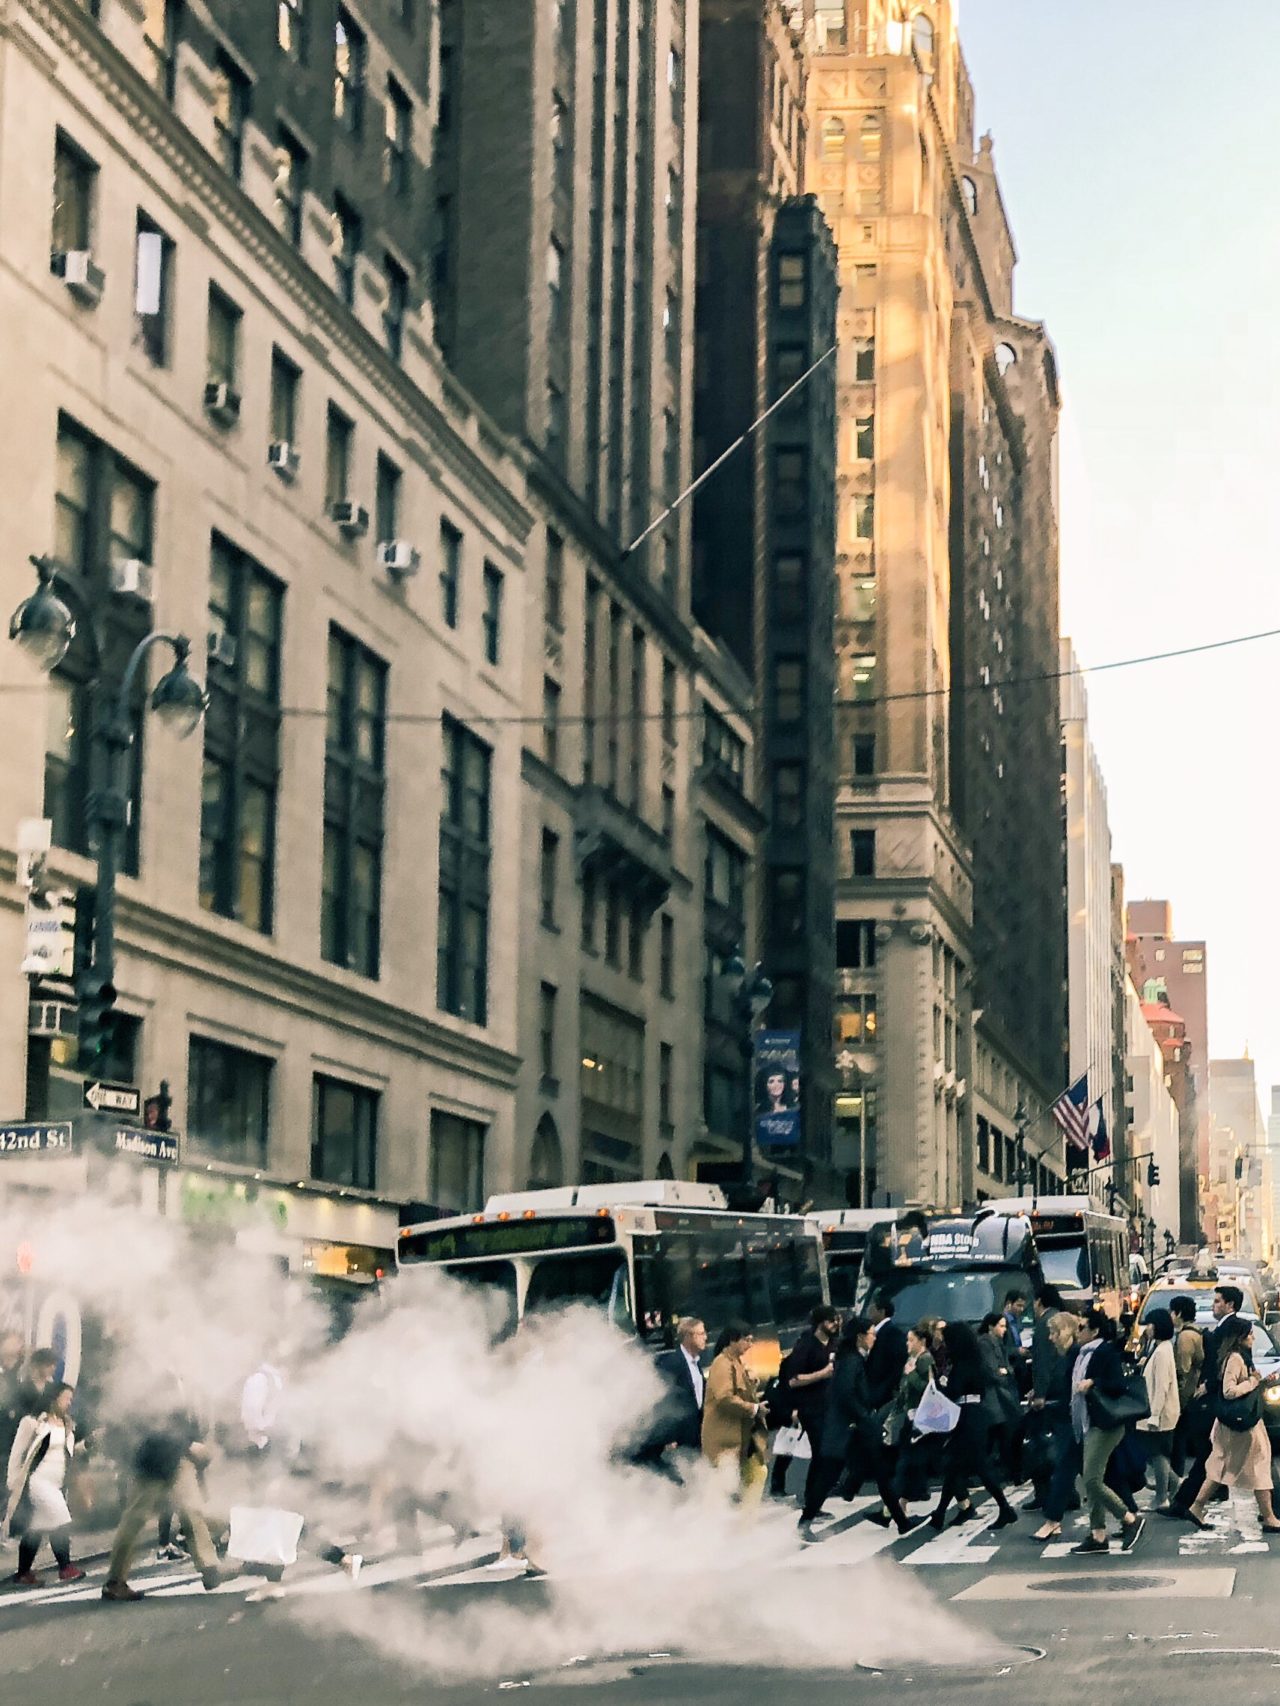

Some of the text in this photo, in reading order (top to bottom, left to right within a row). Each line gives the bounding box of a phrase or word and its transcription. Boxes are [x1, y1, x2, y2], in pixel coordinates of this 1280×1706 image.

[115, 1094, 133, 1105] WAY
[46, 1129, 66, 1148] St
[115, 1131, 176, 1160] Madison Ave
[930, 1233, 953, 1246] NBA
